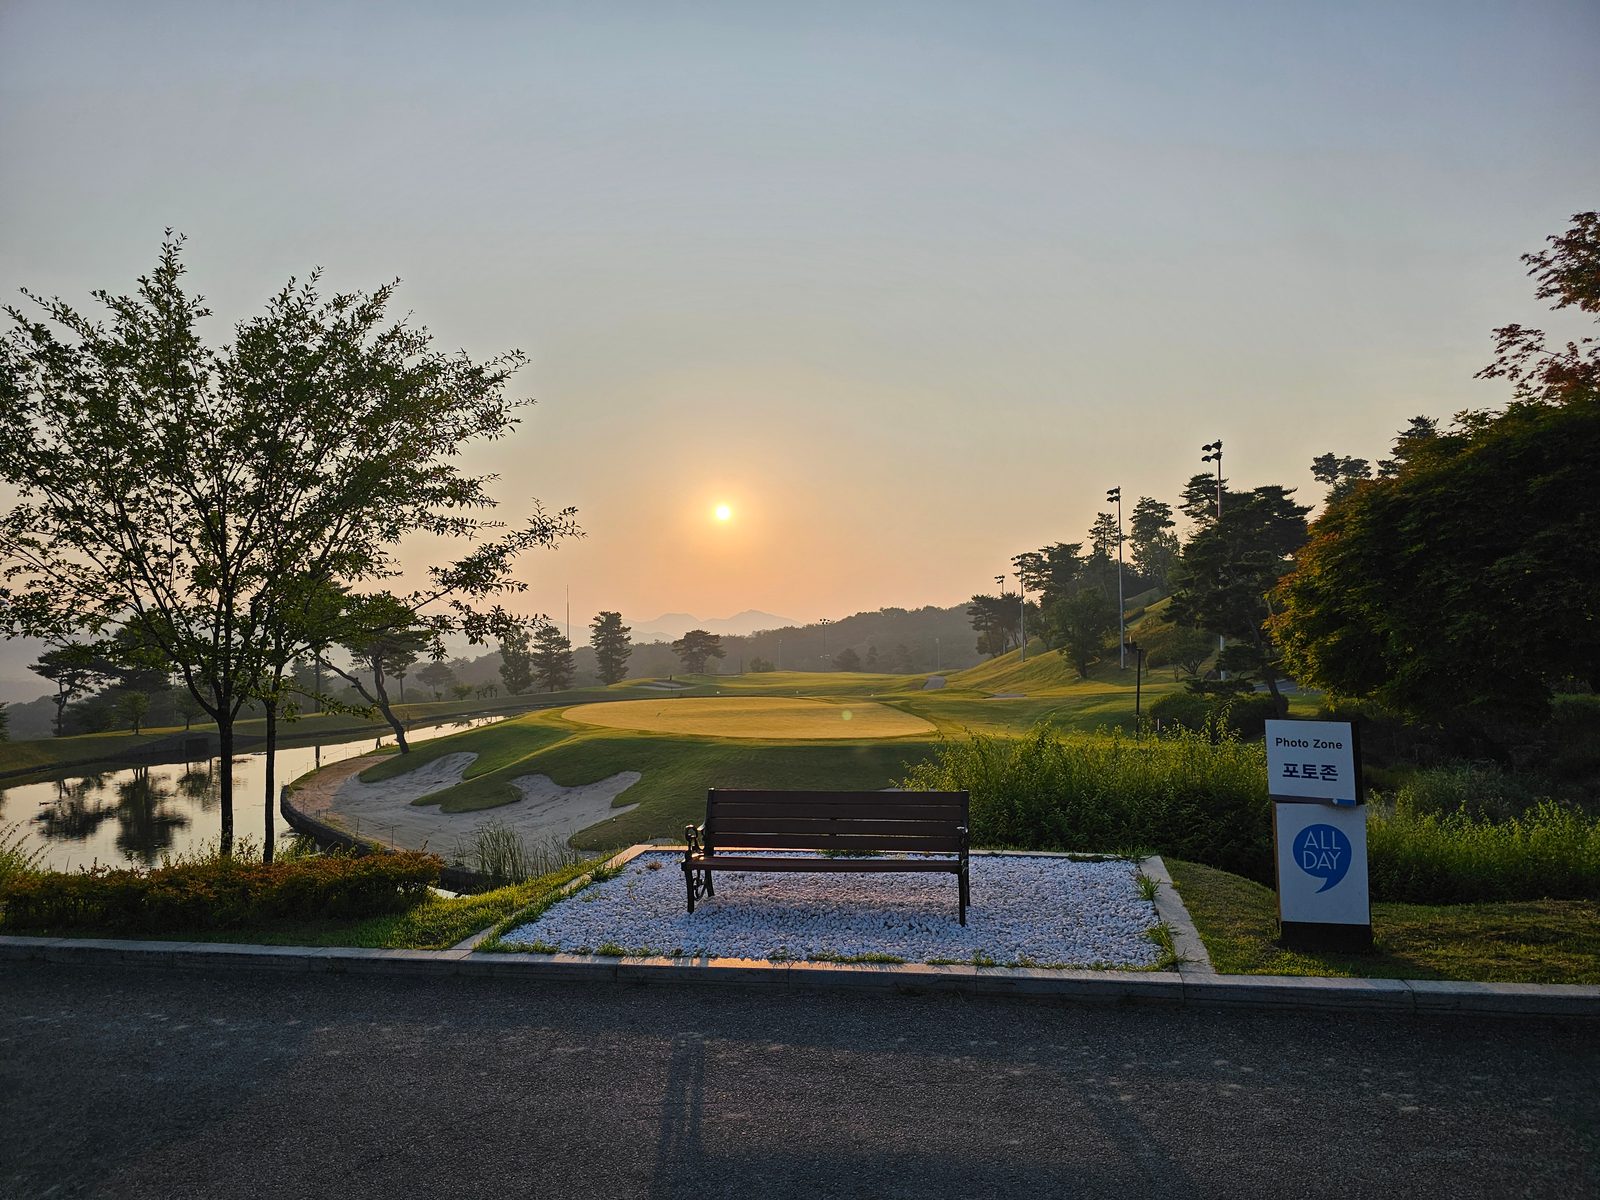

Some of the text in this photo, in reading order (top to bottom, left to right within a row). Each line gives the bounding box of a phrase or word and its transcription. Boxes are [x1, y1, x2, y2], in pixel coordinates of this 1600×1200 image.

[1275, 737, 1343, 750] Photo Zone
[1282, 763, 1339, 781] 포토존
[1303, 830, 1342, 850] ALL
[1303, 850, 1342, 870] DAY
